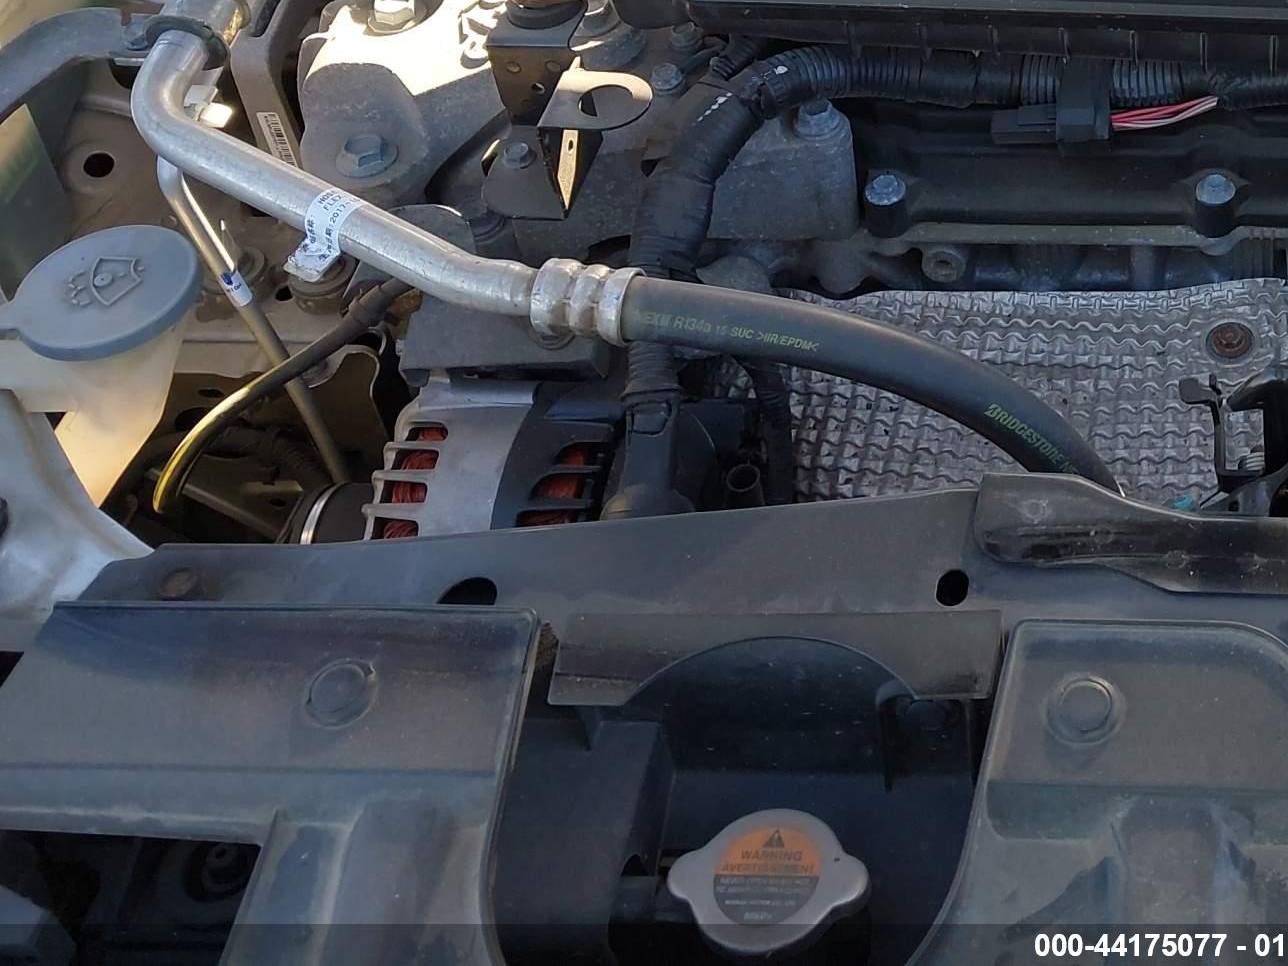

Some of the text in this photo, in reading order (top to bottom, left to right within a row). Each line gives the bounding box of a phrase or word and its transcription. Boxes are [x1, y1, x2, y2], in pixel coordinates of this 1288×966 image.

[730, 326, 755, 339] SUC
[984, 403, 1065, 464] BRIDGESTONE
[741, 850, 803, 861] WARNING
